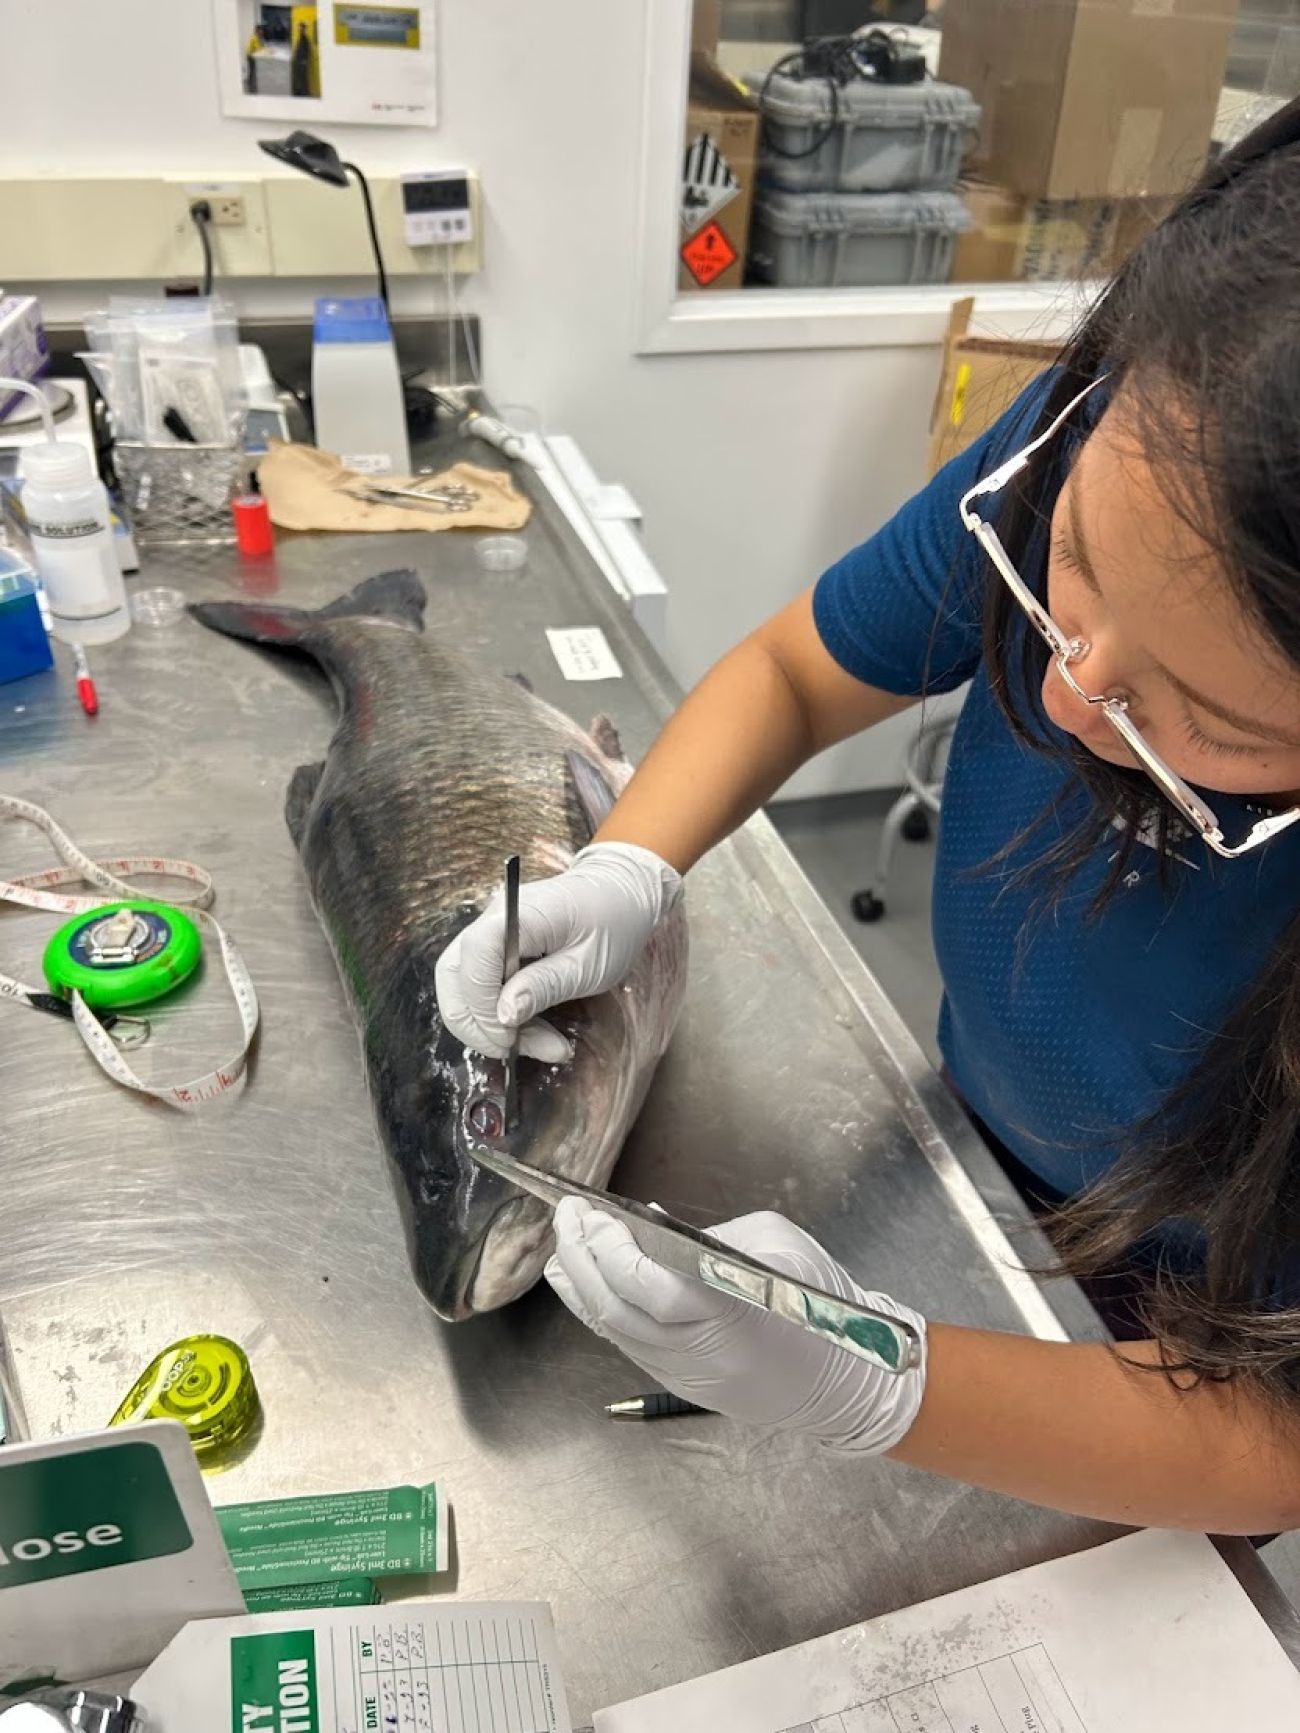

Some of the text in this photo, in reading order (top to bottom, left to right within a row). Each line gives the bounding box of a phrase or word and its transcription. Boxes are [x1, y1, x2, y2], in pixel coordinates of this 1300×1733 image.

[334, 1516, 368, 1525] Syringe
[331, 1559, 401, 1572] BD 3ml Syringe
[361, 1641, 373, 1658] BY
[277, 1659, 312, 1733] TION
[242, 1703, 274, 1733] TY
[364, 1696, 378, 1729] DATE
